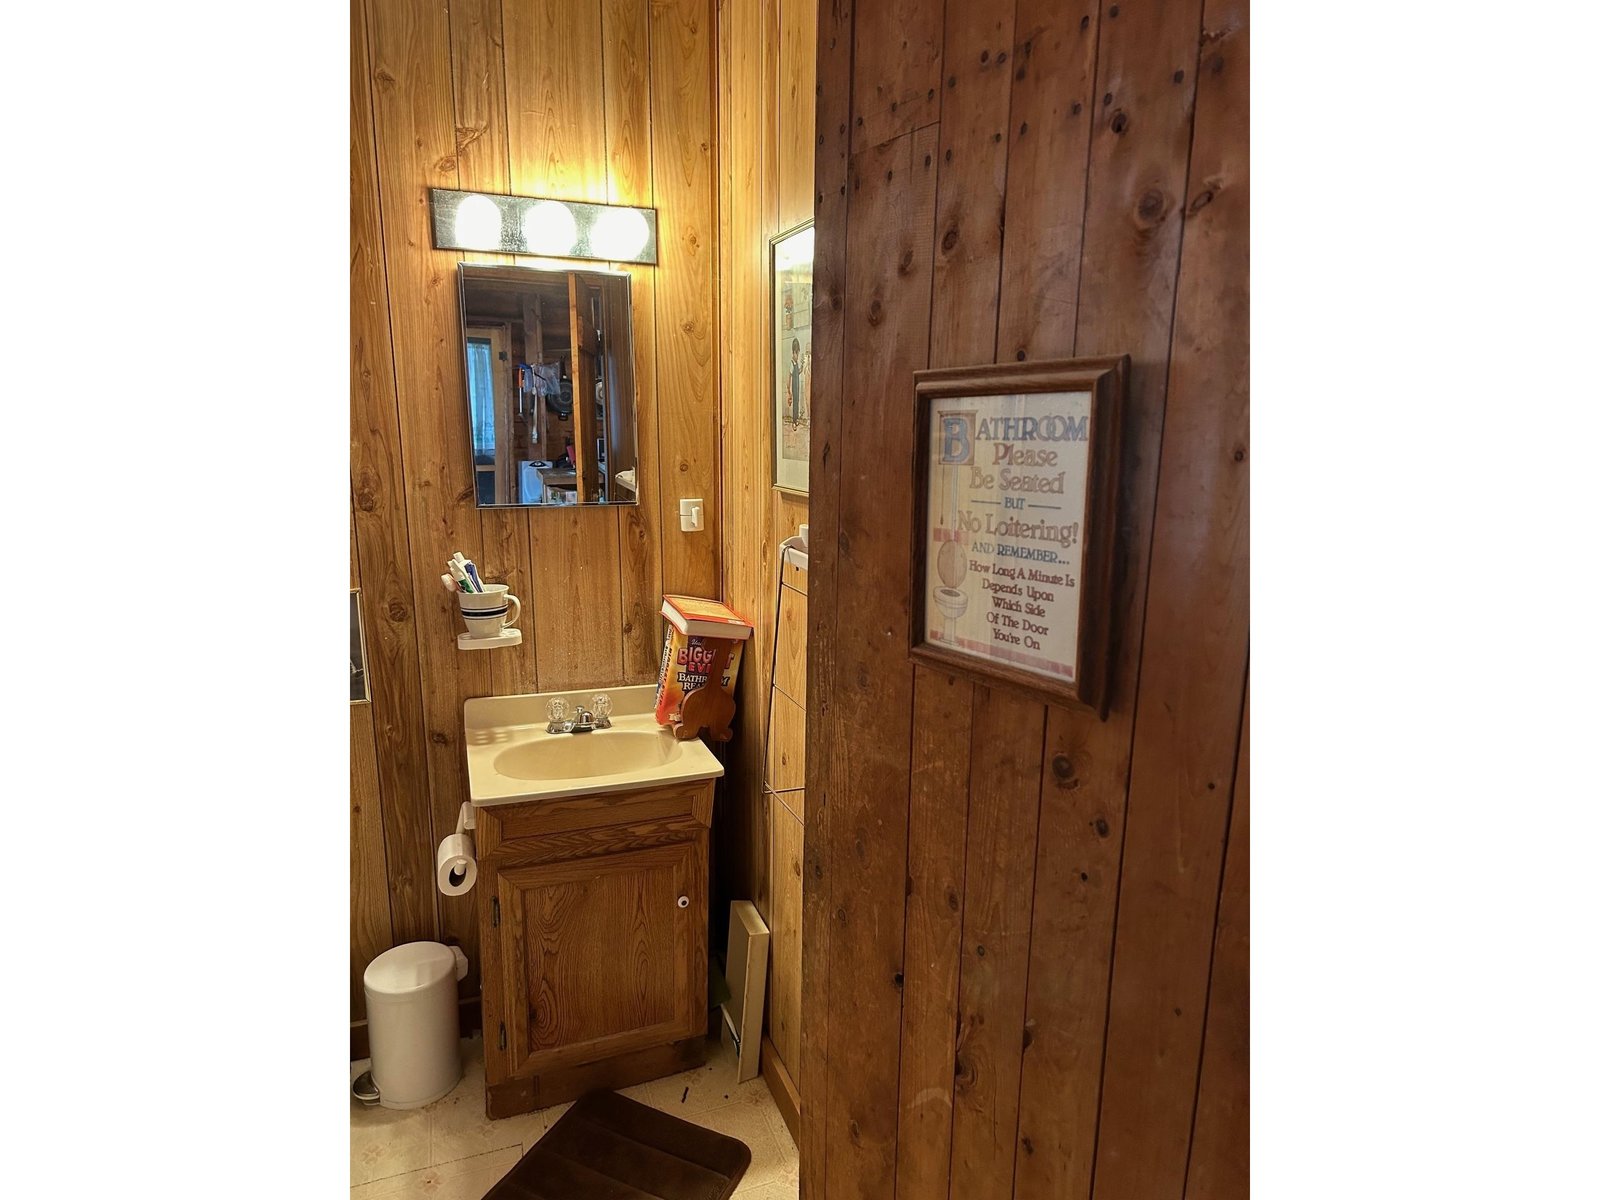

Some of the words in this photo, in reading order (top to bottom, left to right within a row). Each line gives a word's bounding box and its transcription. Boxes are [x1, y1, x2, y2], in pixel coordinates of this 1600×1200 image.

[942, 415, 1088, 463] BATHROOM
[992, 442, 1058, 467] Please
[969, 466, 995, 489] Be
[999, 468, 1066, 494] Seated
[1004, 497, 1026, 510] BUT
[957, 510, 981, 533] No
[985, 514, 1079, 548] Loitering!
[971, 542, 995, 553] AND
[997, 543, 1070, 565] REMEMBER...
[969, 560, 991, 573] How
[992, 563, 1016, 580] Long
[1016, 567, 1026, 580] A
[1028, 569, 1063, 586] Minute
[1065, 574, 1075, 587] Is
[982, 578, 1023, 596] Depends
[1026, 585, 1054, 602] Upon
[992, 596, 1022, 612] Which
[1025, 602, 1046, 618] Side
[986, 612, 999, 624] Of
[1001, 615, 1020, 629] The
[1022, 619, 1049, 636] Door
[992, 628, 1021, 645] You're
[1024, 636, 1040, 650] On
